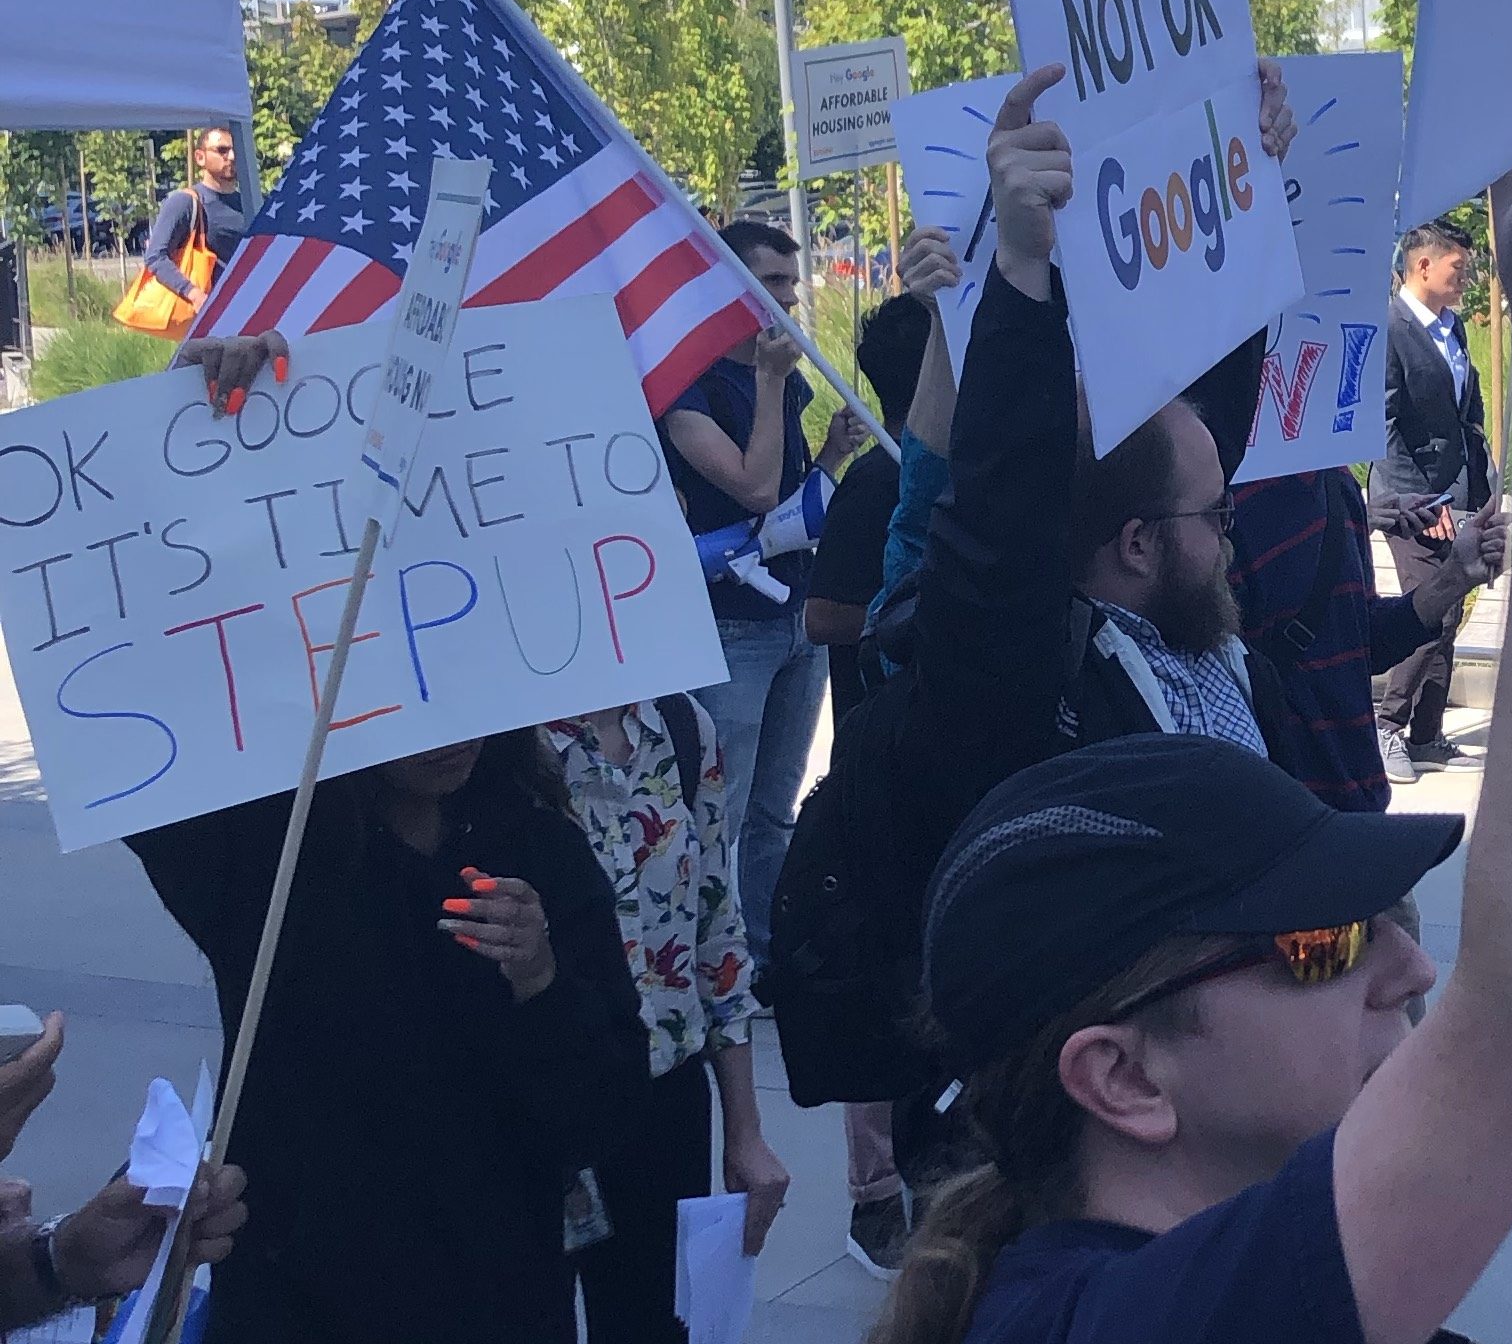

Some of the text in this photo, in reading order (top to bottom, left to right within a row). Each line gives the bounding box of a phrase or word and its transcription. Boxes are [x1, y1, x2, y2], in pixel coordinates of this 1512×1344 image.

[820, 87, 888, 112] AFFORDABLE
[845, 66, 875, 82] Google
[812, 110, 891, 137] HOUSING NOW
[1097, 98, 1253, 291] Google
[0, 430, 115, 527] OK
[12, 430, 661, 652] IT'S TIME TO
